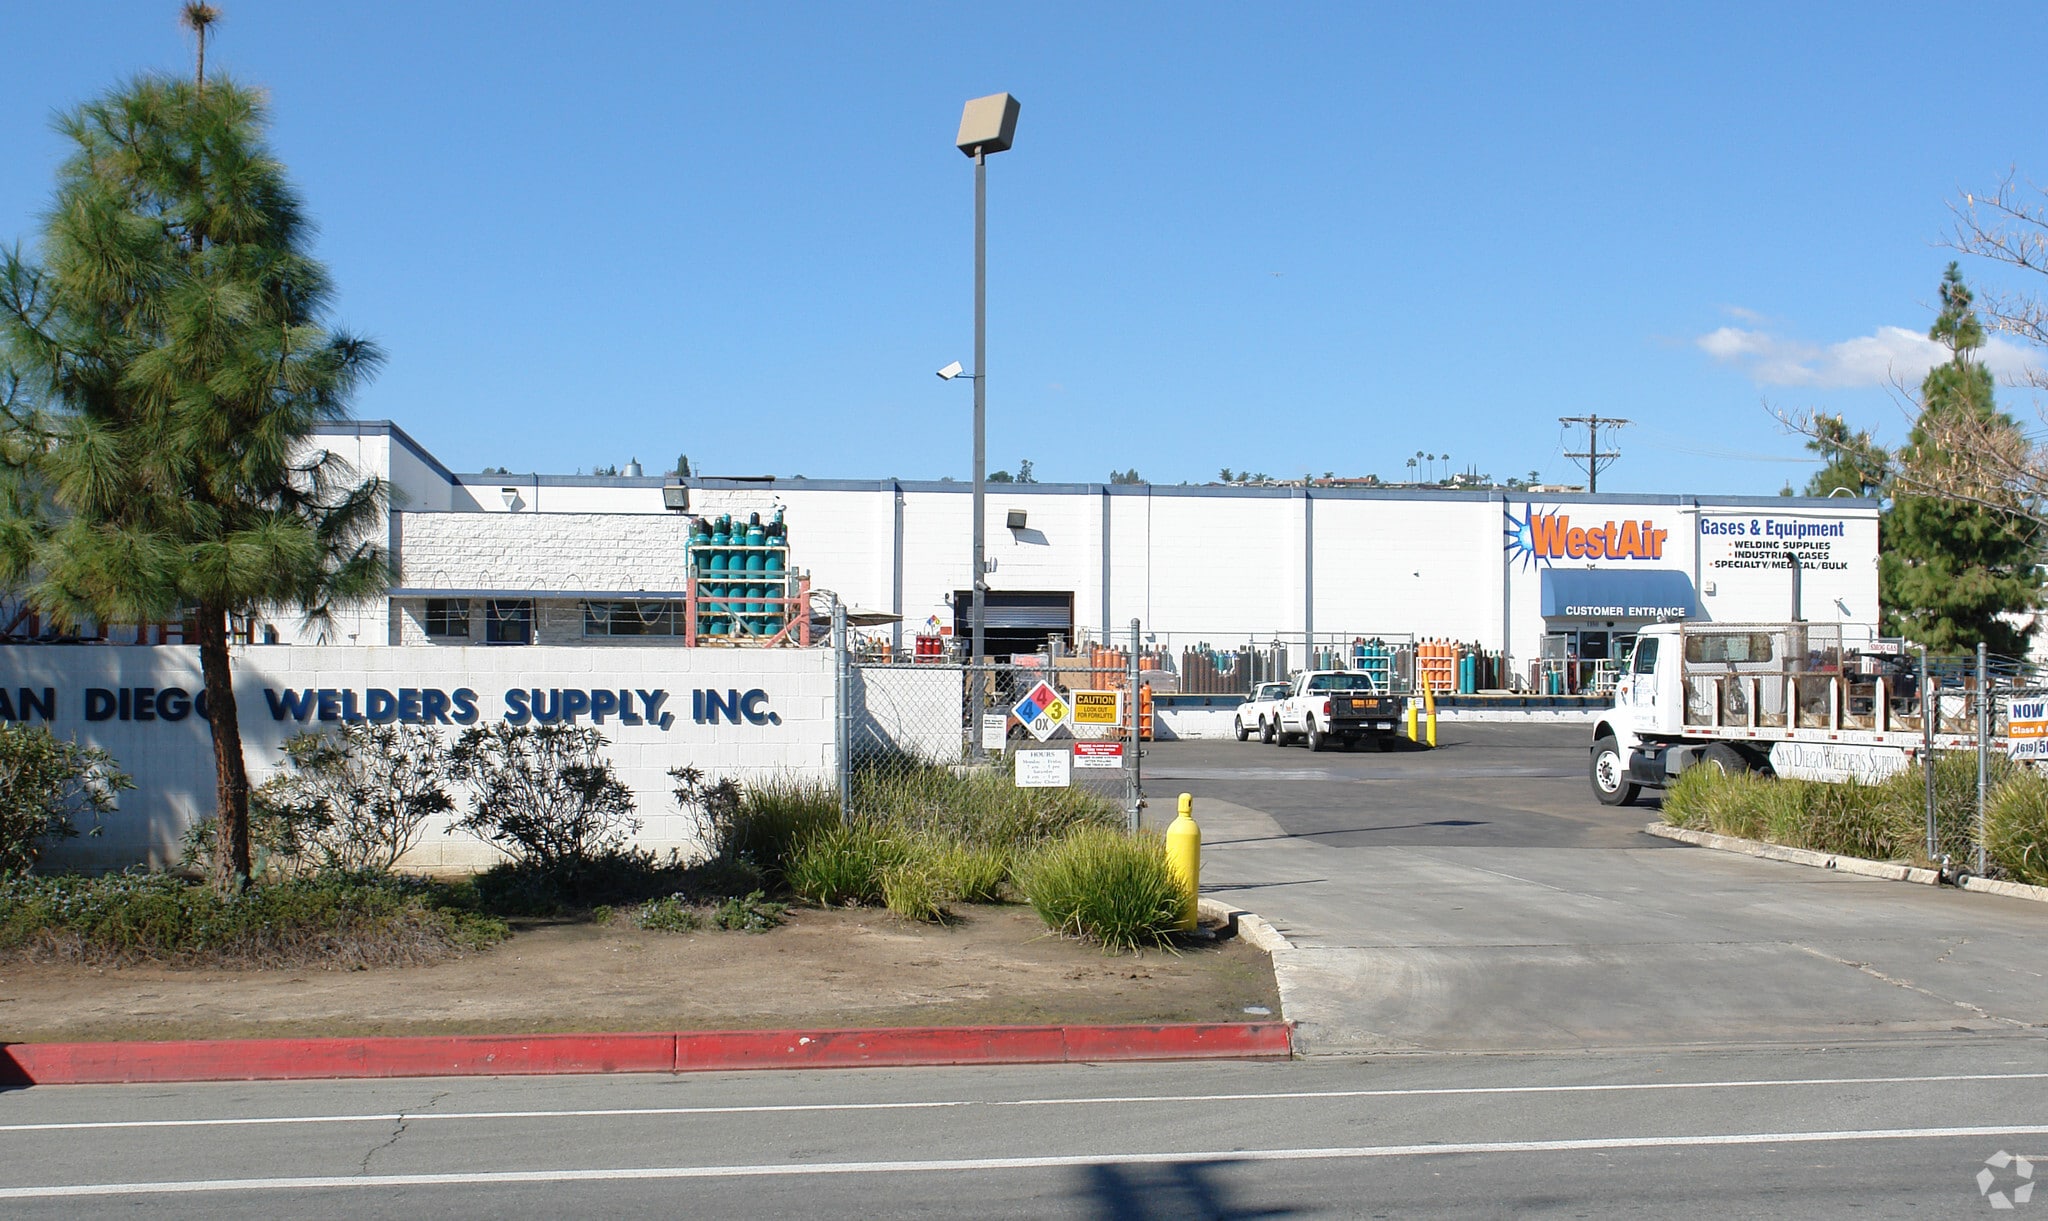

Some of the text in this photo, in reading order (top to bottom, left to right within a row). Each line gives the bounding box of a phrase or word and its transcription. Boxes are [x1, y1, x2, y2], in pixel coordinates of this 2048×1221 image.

[1701, 518, 1844, 539] Gases & Equipment
[1530, 515, 1668, 560] WestAir
[1734, 540, 1831, 550] WELDING SUPPLIES
[1798, 552, 1829, 560] GASES
[1565, 605, 1686, 617] CUSTOMER ENTRANCE
[1037, 688, 1047, 705] 4
[1077, 695, 1115, 704] CAUTION
[263, 687, 480, 726] WELDERS
[503, 687, 675, 731] SUPPLY,
[692, 687, 783, 726] INC.
[1022, 701, 1062, 720] 4 3
[2013, 703, 2044, 718] NOW
[1035, 718, 1049, 731] OX
[2011, 726, 2035, 734] Class
[2036, 725, 2044, 733] A
[2016, 741, 2037, 753] (619)
